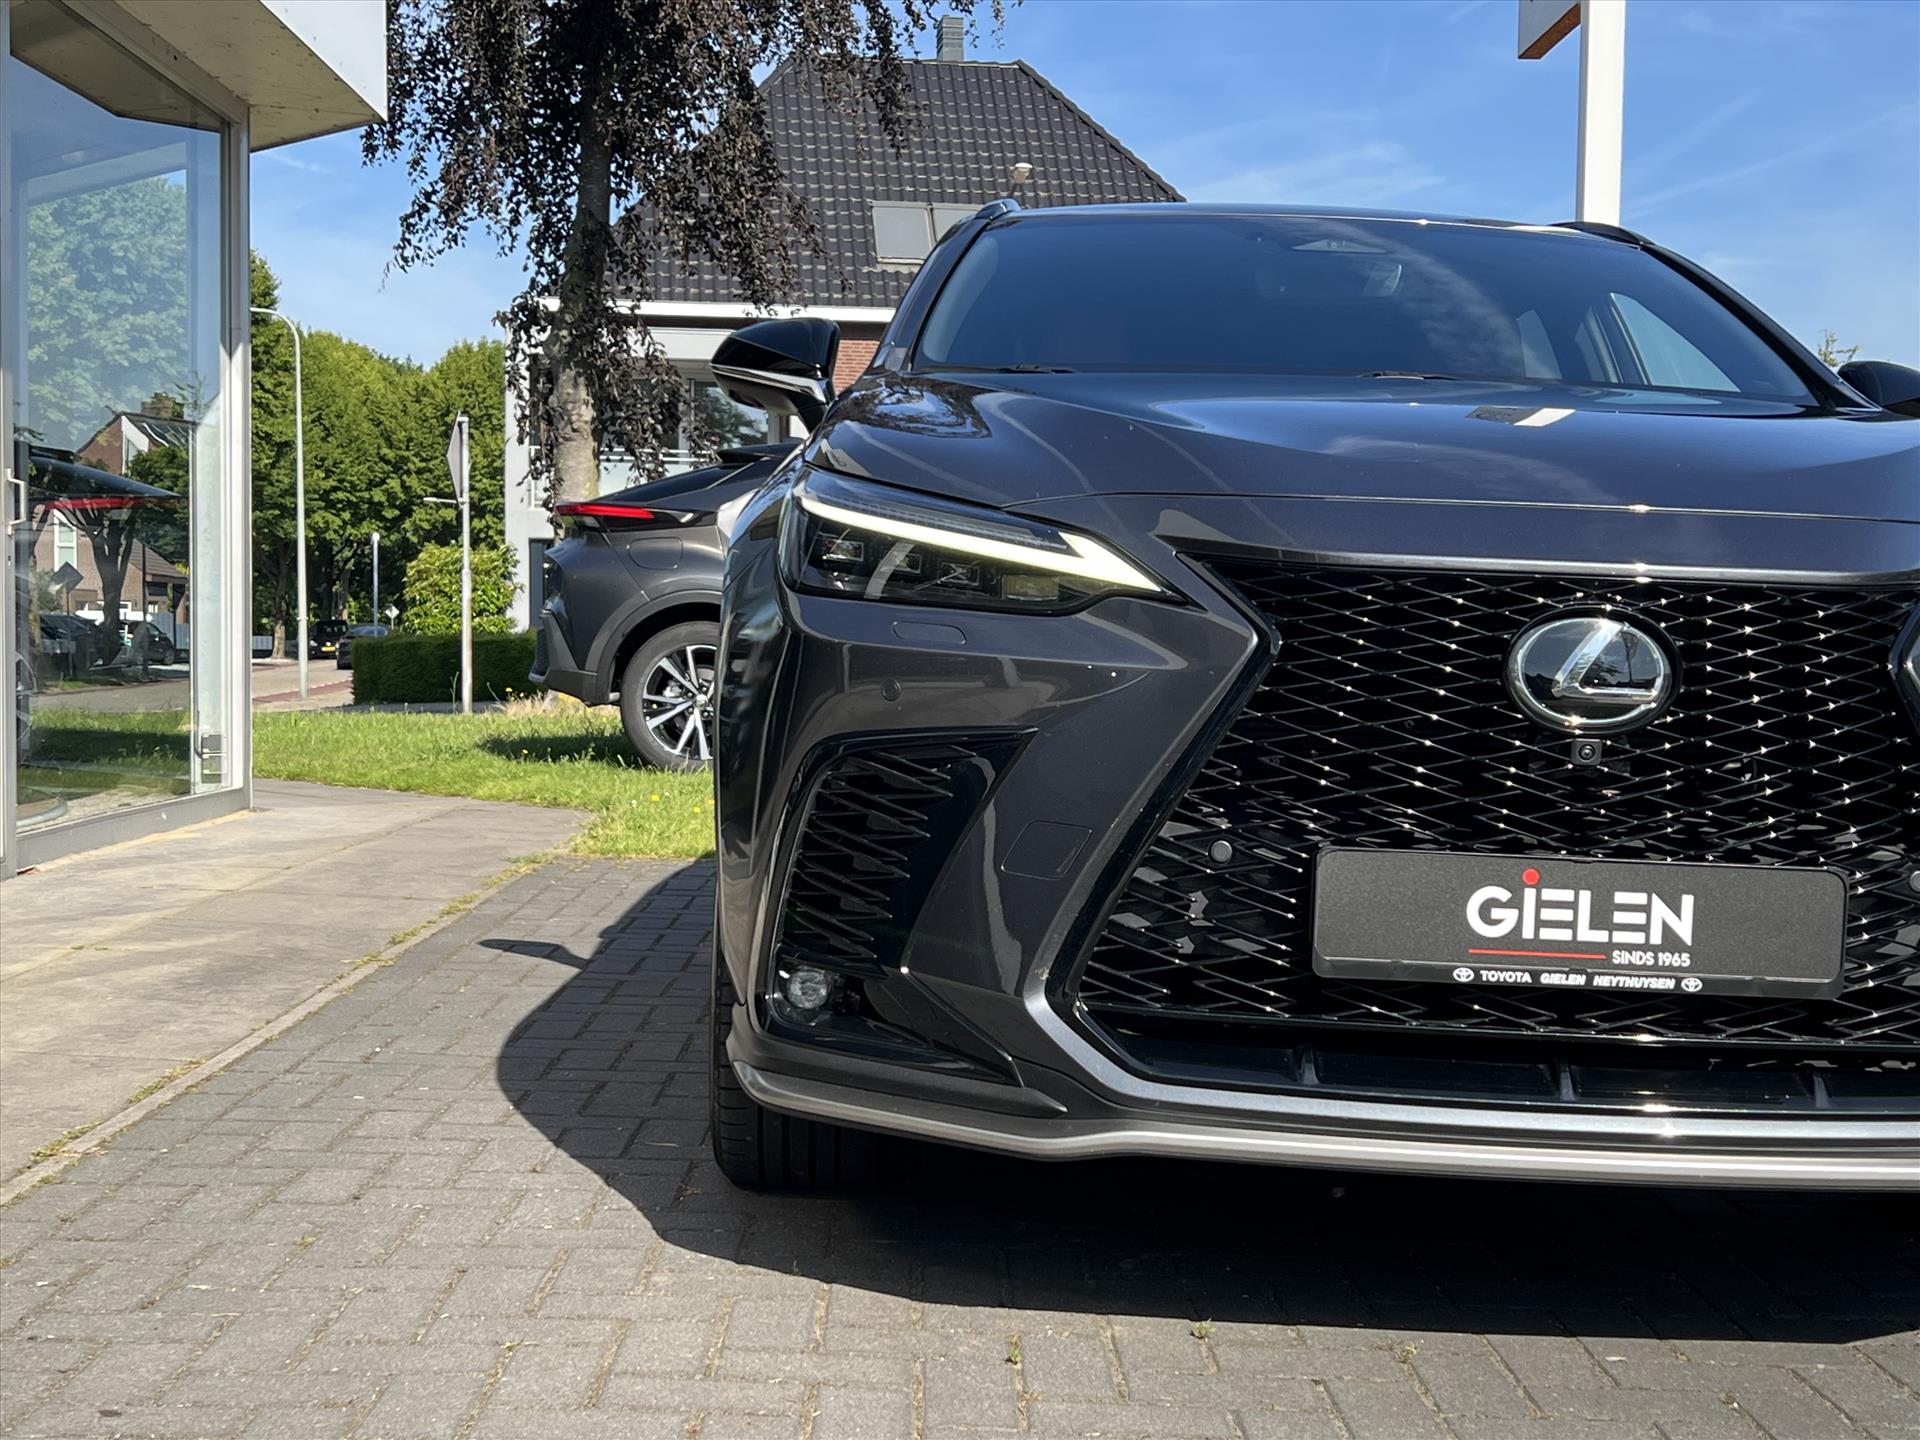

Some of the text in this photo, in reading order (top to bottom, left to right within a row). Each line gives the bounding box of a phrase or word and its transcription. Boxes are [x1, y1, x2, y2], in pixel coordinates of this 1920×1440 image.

[1466, 868, 1694, 946] GIELEN
[1612, 950, 1691, 967] SINDS 1965
[1480, 970, 1676, 990] TOYOTA GIELEN HEYTHUYSEN
